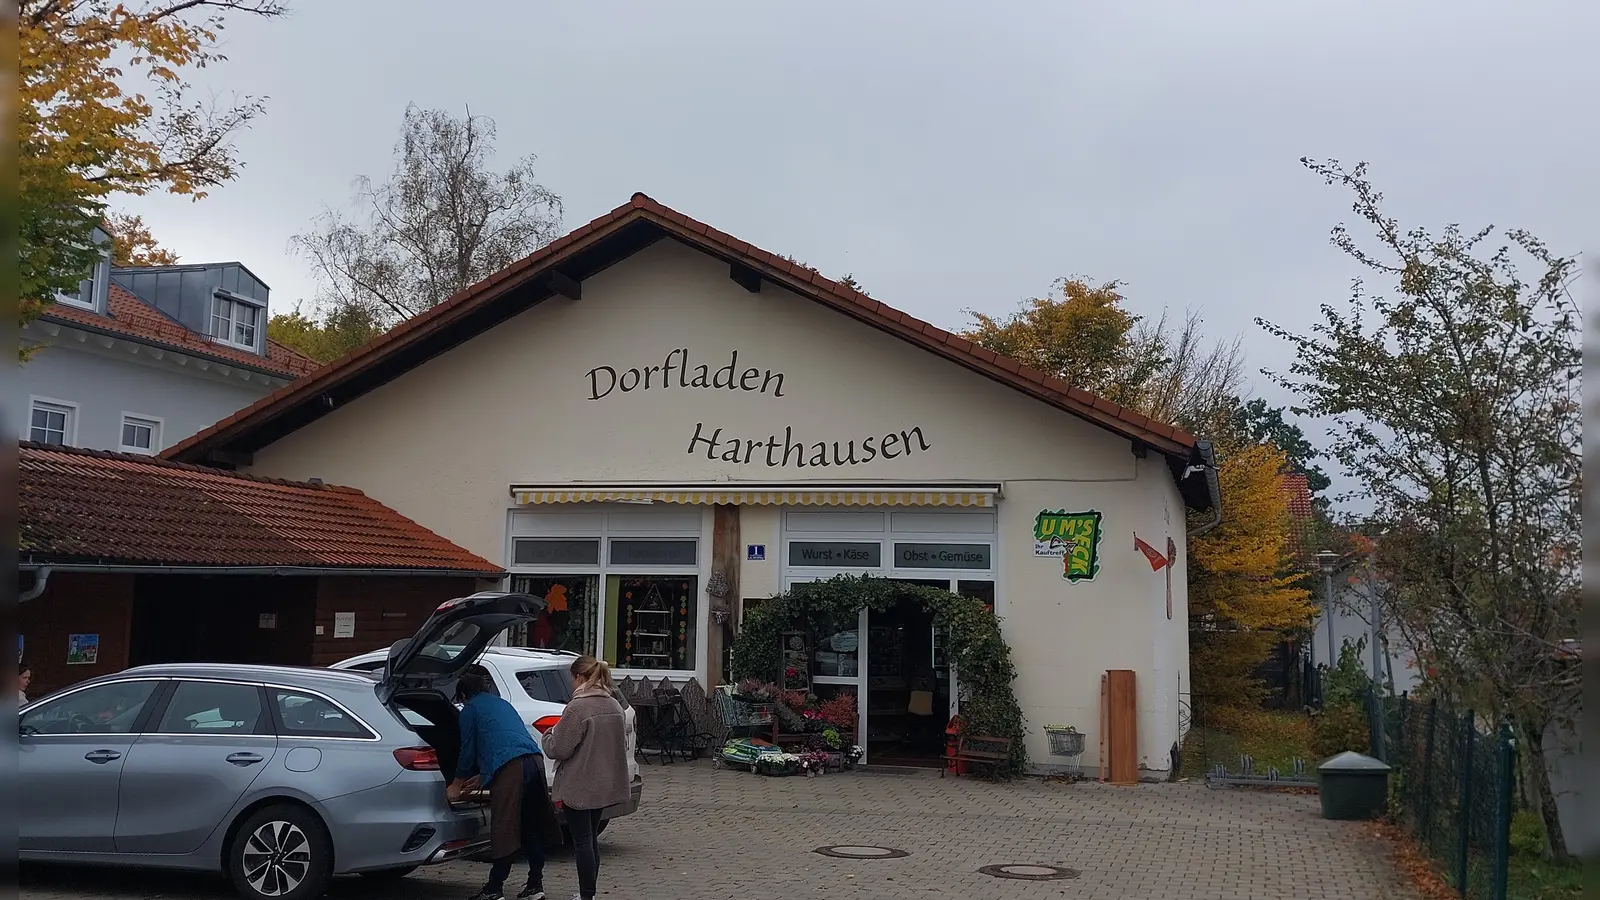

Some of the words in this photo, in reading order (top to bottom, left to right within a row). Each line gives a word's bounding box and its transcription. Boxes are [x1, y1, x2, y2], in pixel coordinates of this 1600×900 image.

[585, 348, 785, 401] Dorfladen
[687, 422, 931, 468] Harthausen
[802, 549, 832, 560] Wurst
[843, 549, 869, 561] Käse
[903, 549, 928, 562] Obst
[938, 549, 983, 563] Gemüse
[1072, 535, 1091, 575] ECK
